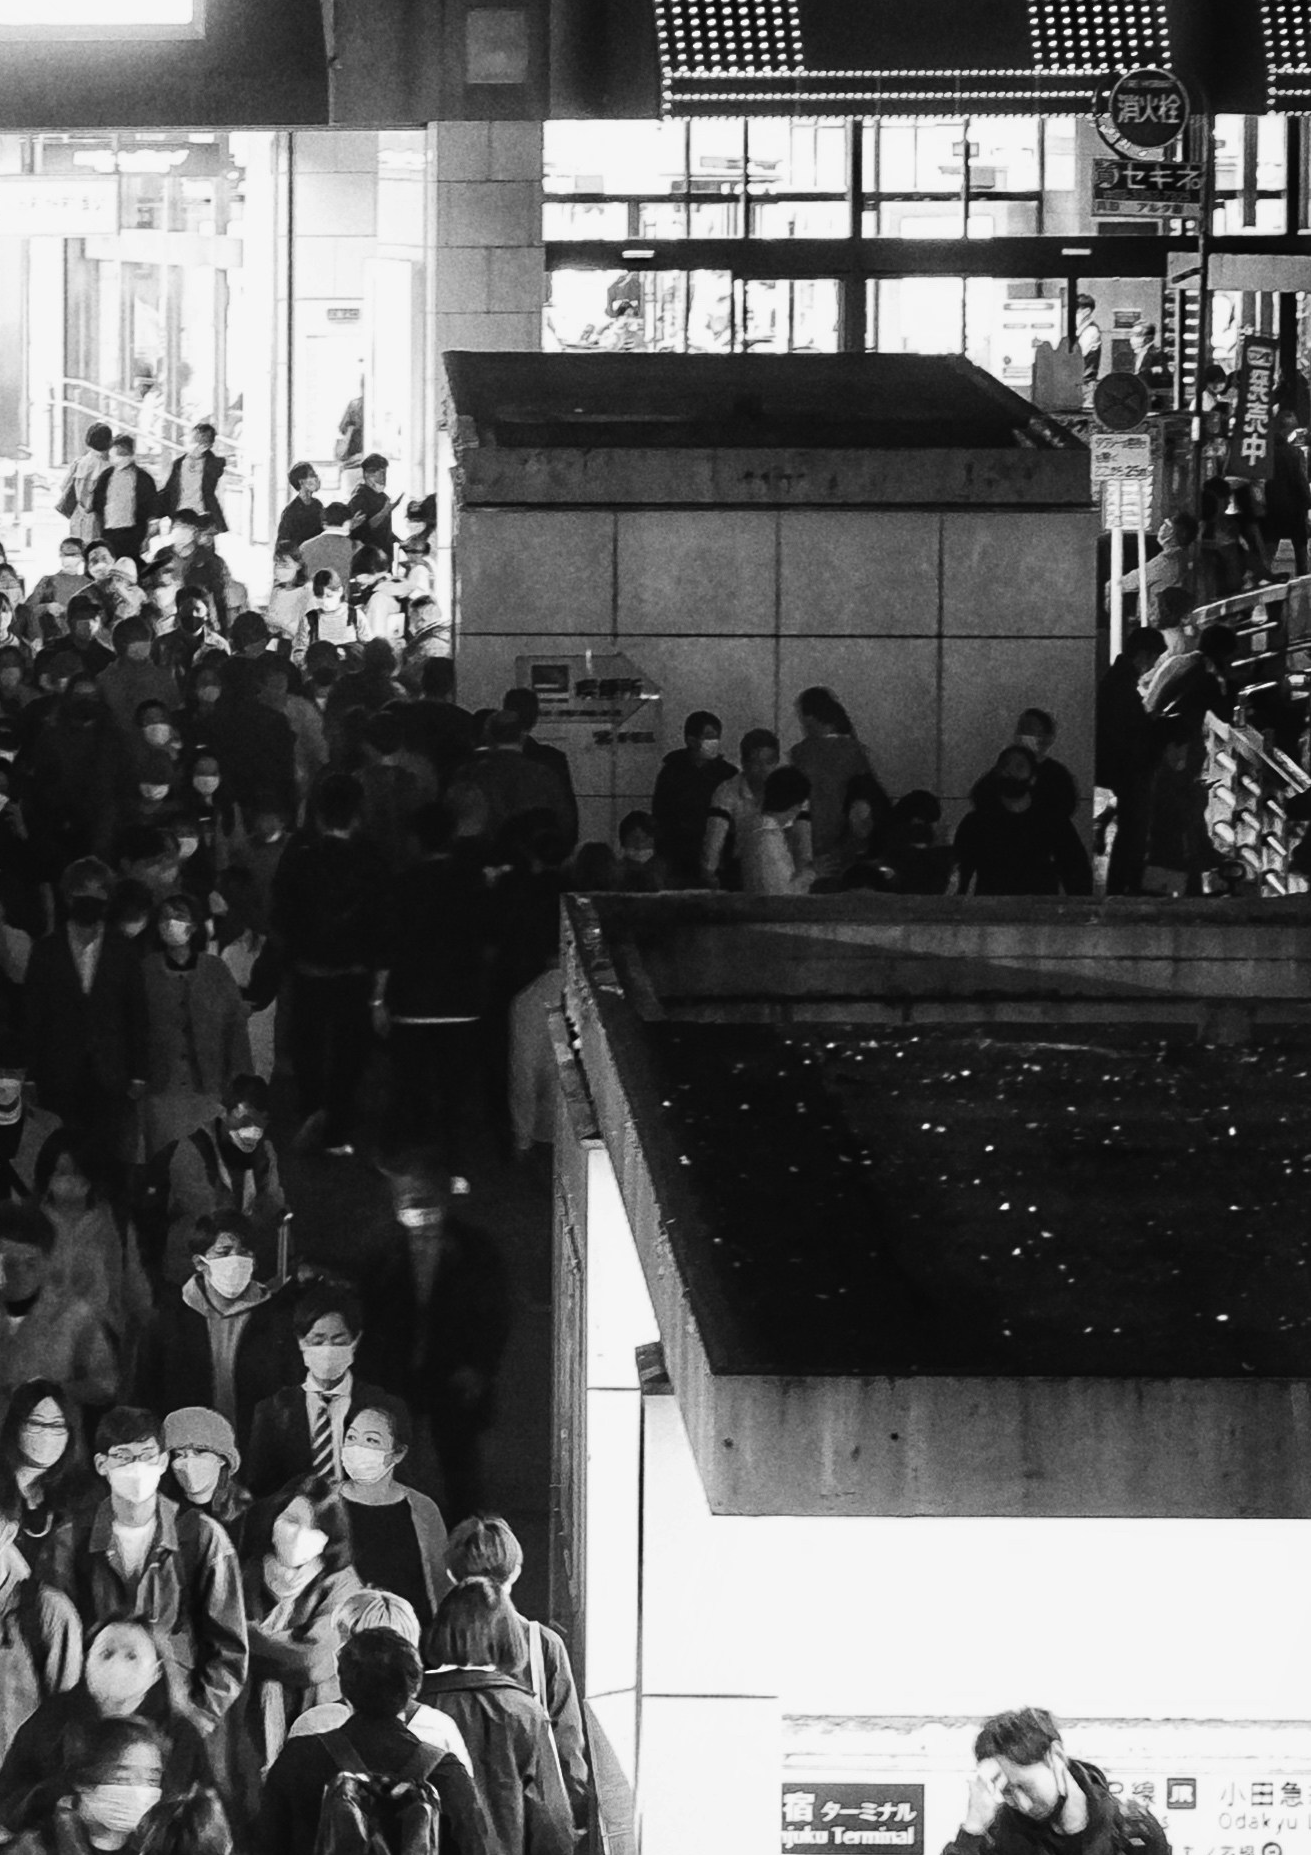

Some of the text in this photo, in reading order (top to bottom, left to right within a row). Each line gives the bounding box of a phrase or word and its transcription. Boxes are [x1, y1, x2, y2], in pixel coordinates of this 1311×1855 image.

[1117, 93, 1181, 124] 消火栓
[783, 1790, 918, 1823] 宿 ターミナル
[1219, 1780, 1311, 1808] 小田急
[830, 1824, 916, 1846] Terminal
